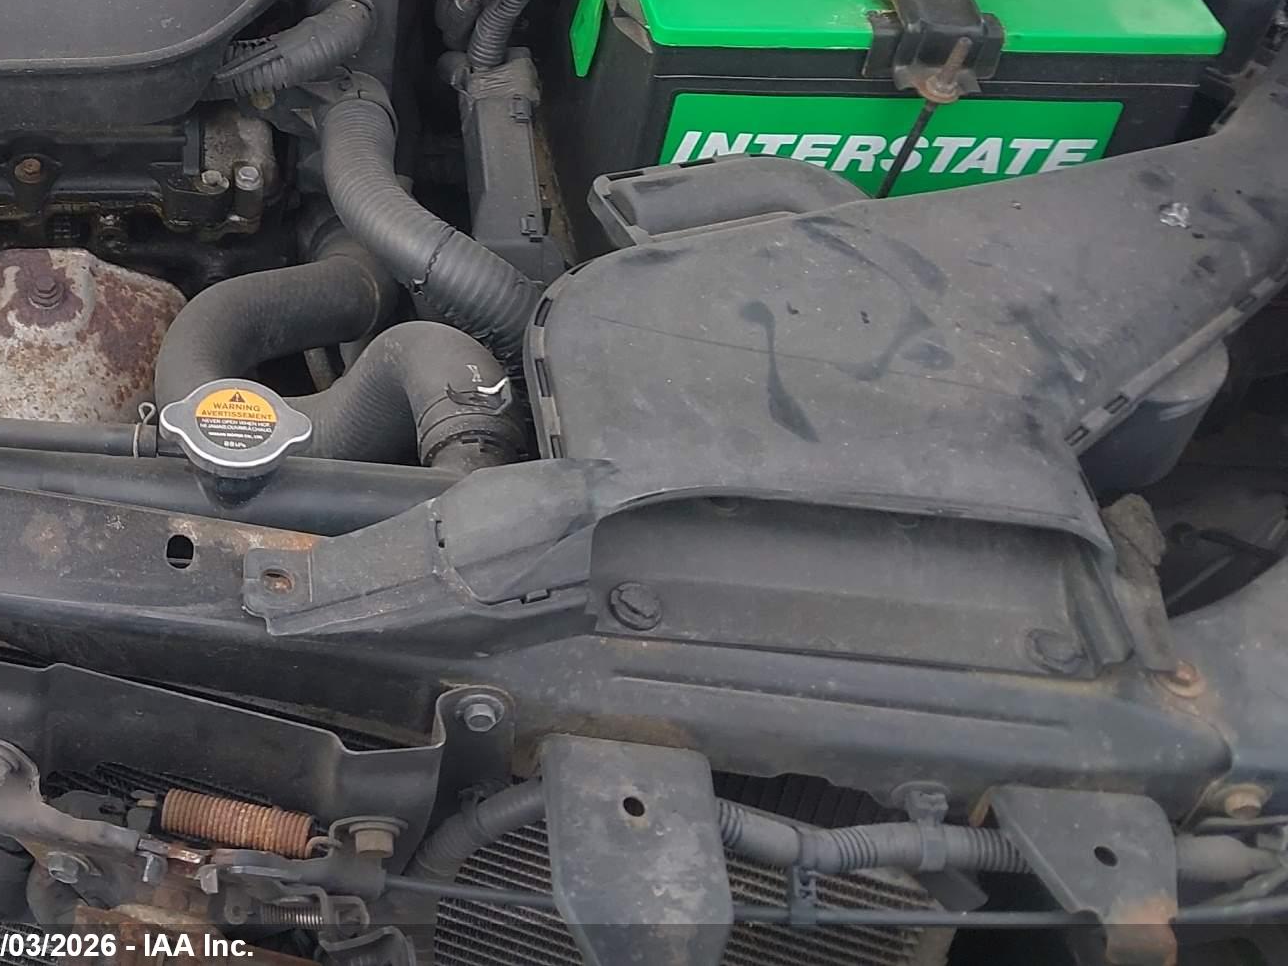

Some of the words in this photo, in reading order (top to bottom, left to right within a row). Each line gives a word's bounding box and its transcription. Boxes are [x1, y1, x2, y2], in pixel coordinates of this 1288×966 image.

[670, 130, 1098, 175] INTERSTATE
[213, 402, 261, 412] WARNING
[201, 409, 273, 420] AVERTISSEMENT
